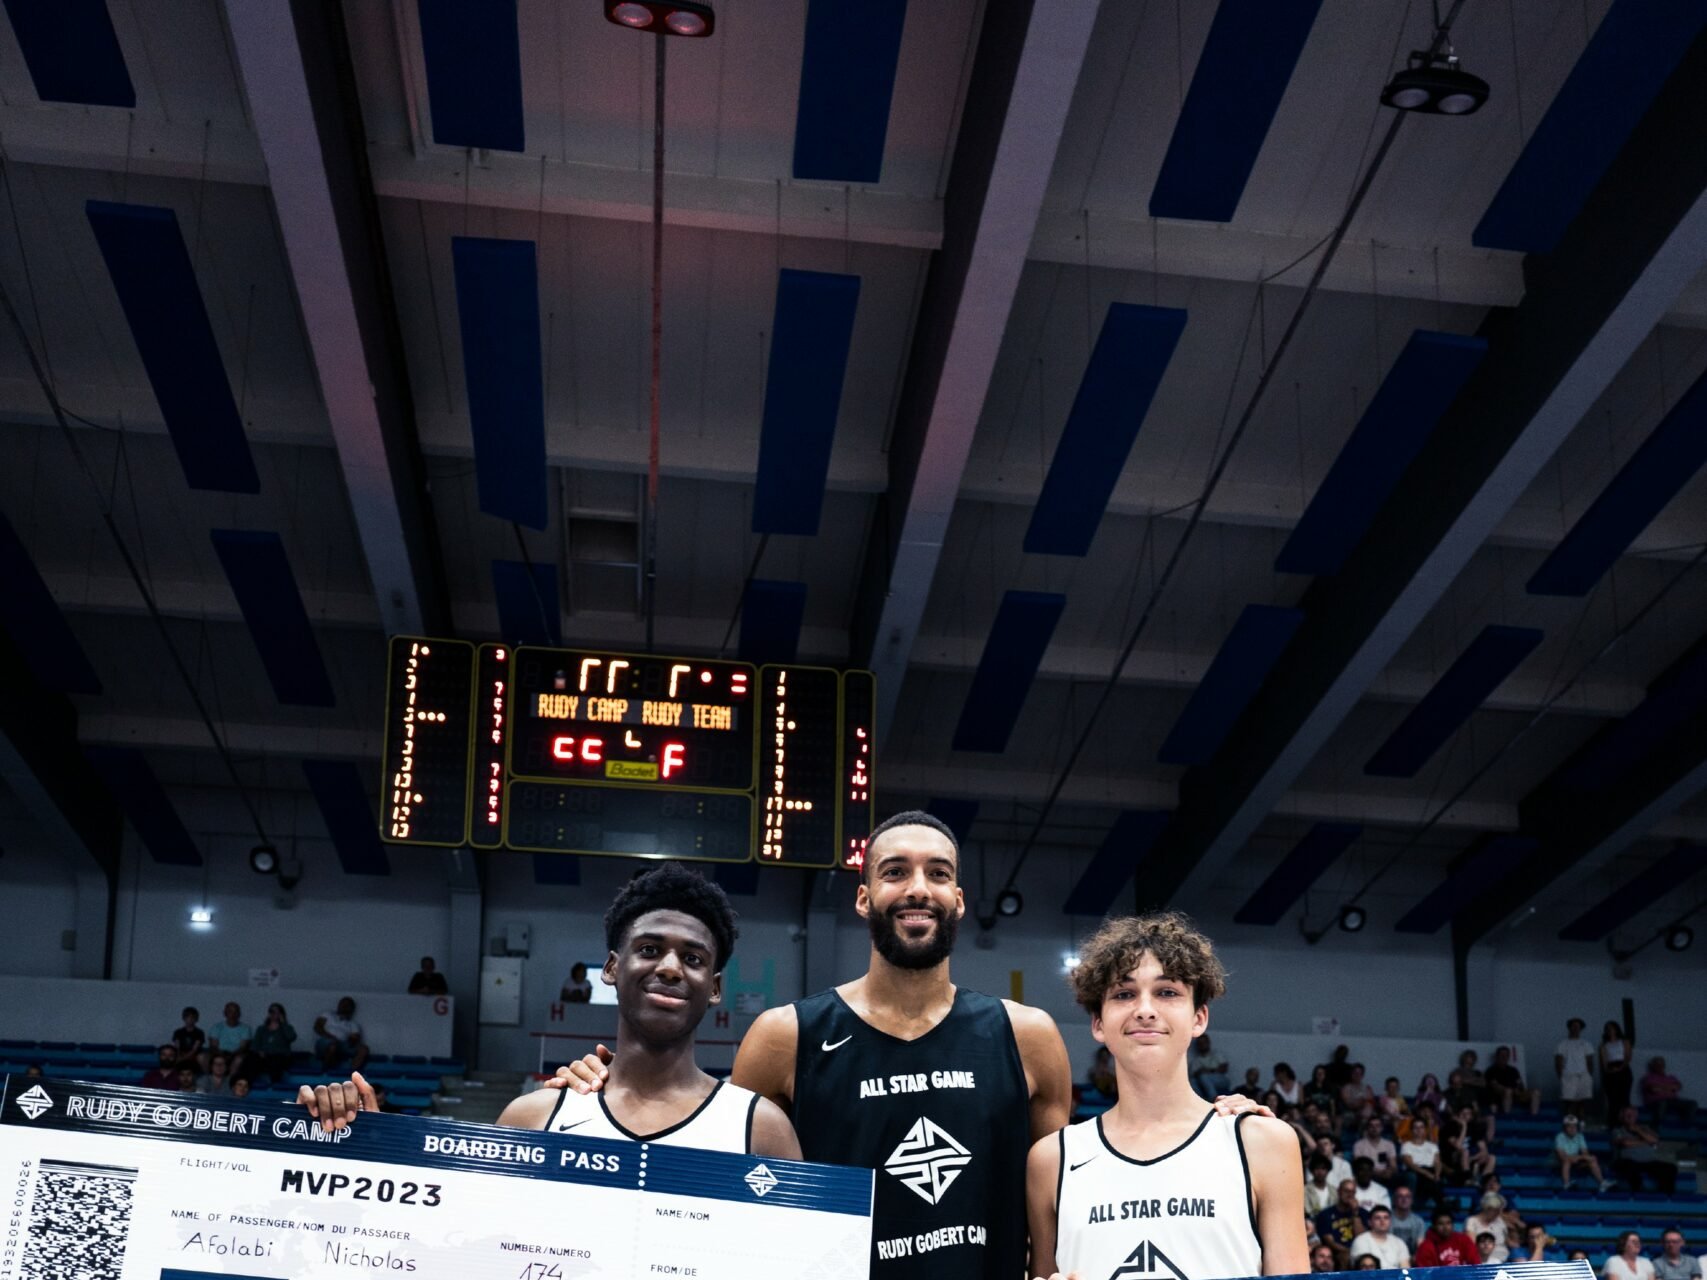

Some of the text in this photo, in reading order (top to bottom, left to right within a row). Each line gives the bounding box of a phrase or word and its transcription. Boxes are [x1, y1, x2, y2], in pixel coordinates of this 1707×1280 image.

[538, 693, 732, 730] RUDY CAMP RUDY TEAM
[433, 1000, 449, 1016] G
[550, 1002, 565, 1021] H
[715, 1010, 729, 1028] H
[860, 1070, 975, 1099] ALL STAR GAME
[67, 1096, 145, 1122] RUDY
[152, 1104, 265, 1135] GOBERT
[180, 1157, 252, 1173] FLIGHT/VOL
[424, 1134, 620, 1172] BOARDING PASS
[281, 1168, 442, 1207] MVP2023
[171, 1210, 411, 1240] NAME OF PASSENGER/NOM DU PASSAGER
[656, 1208, 710, 1222] NAME/NOM
[1088, 1196, 1216, 1225] ALL STAR GAME
[183, 1231, 417, 1272] Afolabi Nicholas
[500, 1242, 591, 1259] NUMBER/NUMERO
[877, 1236, 914, 1261] RUDY
[916, 1226, 966, 1254] GOBERT
[650, 1264, 697, 1277] FROM/DE
